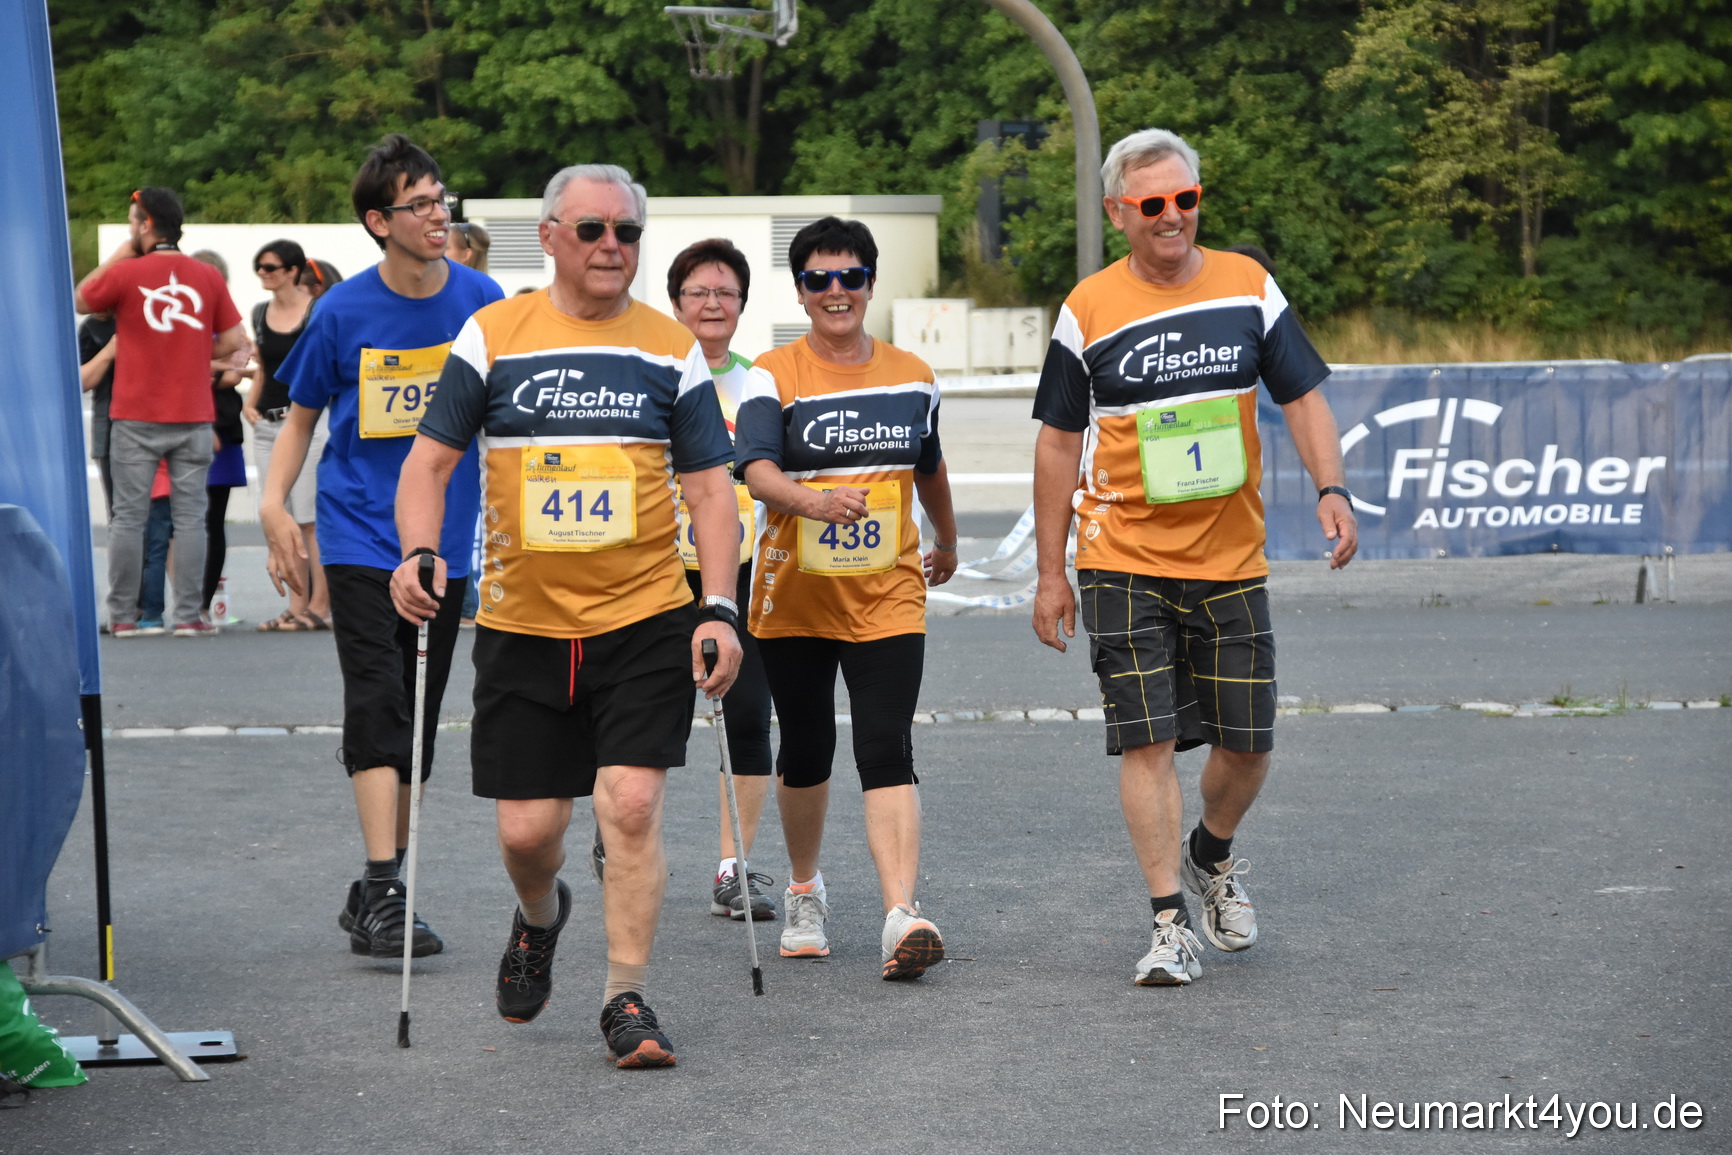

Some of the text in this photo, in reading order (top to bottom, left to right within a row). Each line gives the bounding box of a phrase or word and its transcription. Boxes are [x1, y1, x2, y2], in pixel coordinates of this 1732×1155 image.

[1142, 343, 1242, 375] Fischer
[1154, 363, 1239, 384] AUTOMOBILE
[535, 386, 647, 407] Fischer
[545, 408, 641, 419] AUTOMOBILE
[825, 422, 912, 444] Fischer
[834, 440, 910, 454] AUTOMOBILE
[1186, 441, 1202, 472] 1
[1387, 444, 1667, 499] Fischer
[541, 489, 613, 522] 414
[1412, 503, 1644, 530] AUTOMOBILE
[548, 529, 573, 537] August
[818, 519, 881, 550] 438
